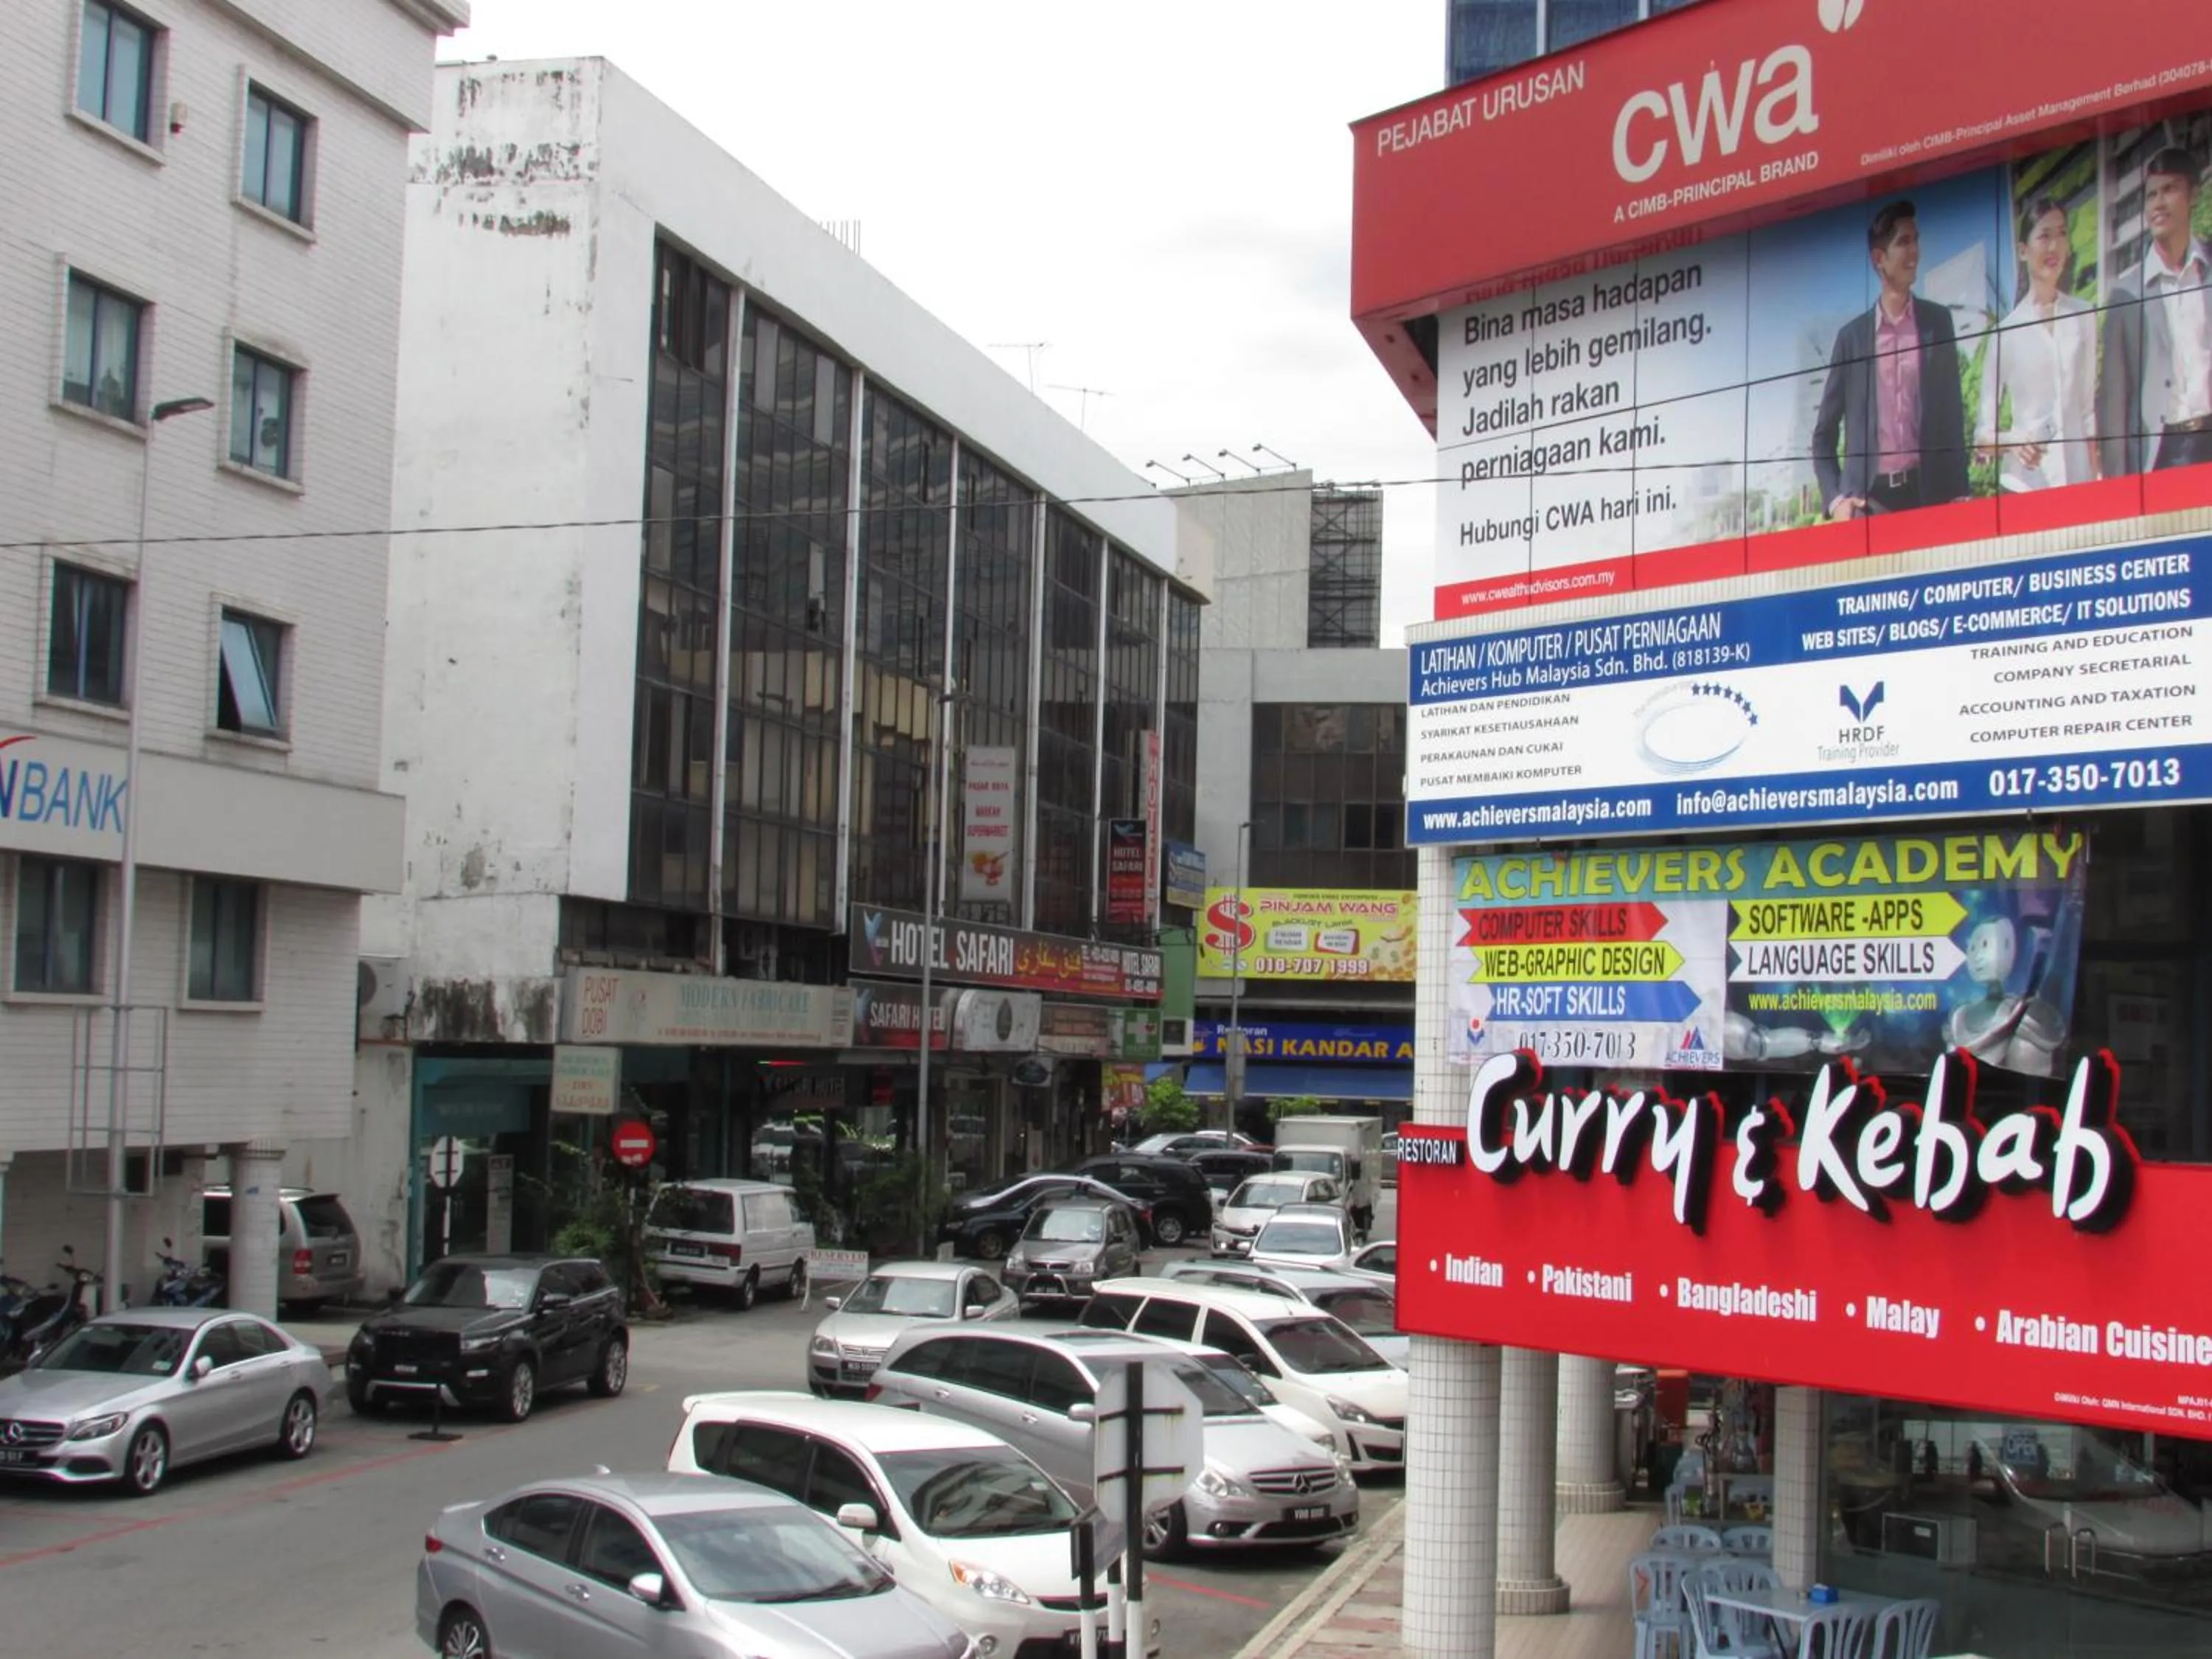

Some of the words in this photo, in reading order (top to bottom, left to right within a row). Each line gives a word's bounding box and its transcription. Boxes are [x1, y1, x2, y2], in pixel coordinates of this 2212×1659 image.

[1377, 98, 1476, 156] PEJABAT
[1483, 60, 1586, 121] URUSAN
[1923, 117, 2003, 150] CIMB-Principal
[2005, 108, 2036, 128] Asset
[2038, 86, 2111, 117] Management
[2114, 74, 2157, 97] Berhad
[1614, 206, 1625, 224] A
[1628, 169, 1756, 220] CIMB-PRINCIPAL
[1759, 151, 1819, 184] BRAND
[1464, 313, 1514, 346] Bina
[1521, 297, 1585, 330] masa
[1593, 262, 1702, 313] hadapan
[1463, 357, 1517, 397] yang
[1524, 337, 1581, 377] lebih
[1588, 312, 1712, 367] gemilang.
[1462, 394, 1544, 437] Jadilah
[1551, 380, 1620, 418] rakan
[1461, 434, 1591, 490] perniagaan
[1599, 415, 1666, 457] kami.
[1460, 509, 1540, 547] Hubungi
[1545, 499, 1594, 532] CWA
[1601, 490, 1640, 520] hari
[1646, 484, 1677, 514] ini.
[1461, 569, 1615, 605] www.cwealthadvisors.com.my
[1837, 588, 1919, 616] TRAINING/
[1924, 575, 2025, 606] COMPUTER/
[2028, 563, 2116, 594] BUSINESS
[2121, 554, 2191, 580] CENTER
[1801, 631, 1834, 652] WEB
[1837, 624, 1884, 648] SITES/
[1889, 616, 1949, 642] BLOGS/
[1953, 601, 2073, 636] E-COMMERCE/
[2077, 598, 2093, 619] IT
[2095, 588, 2191, 617] SOLUTIONS
[1420, 645, 1475, 675] LATIHAN
[1487, 632, 1563, 668] KOMPUTER
[1574, 625, 1621, 655] PUSAT
[1624, 611, 1722, 650] PERNIAGAAN
[1971, 640, 2048, 660] TRAINING
[2052, 636, 2089, 653] AND
[2093, 626, 2194, 647] EDUCATION
[1420, 673, 1488, 698] Achievers
[1492, 668, 1522, 690] Hub
[1526, 658, 1591, 689] Malaysia
[1595, 655, 1629, 678] Sdn.
[1633, 650, 1669, 672] Bhd.
[1672, 643, 1751, 672] (818139-K)
[1993, 664, 2074, 684] COMPANY
[2078, 653, 2191, 676] SECRETARIAL
[1420, 703, 1467, 719] LATIHAN
[1470, 699, 1495, 714] DAN
[1497, 693, 1571, 711] PENDIDIKAN
[1958, 695, 2066, 716] ACCOUNTING
[2069, 691, 2107, 706] AND
[2110, 684, 2196, 703] TAXATION
[1420, 724, 1472, 740] SYARIKAT
[1473, 715, 1579, 736] KESETIAUSAHAAN
[1839, 726, 1885, 745] HRDF
[1970, 725, 2059, 744] COMPUTER
[2063, 720, 2123, 737] REPAIR
[2126, 714, 2193, 733] CENTER
[1420, 746, 1496, 765] PERAKAUNAN
[1498, 743, 1524, 758] DAN
[1526, 740, 1564, 755] CUKAI
[1817, 743, 1857, 764] Training
[1859, 742, 1899, 760] Provider
[1420, 773, 1455, 788] PUSAT
[1455, 769, 1514, 785] MEMBAIKI
[1515, 764, 1582, 782] KOMPUTER
[1423, 798, 1652, 830] www.achieversmalaysia.com
[1677, 776, 1958, 815] info@achieversmalaysia.com
[1989, 757, 2180, 797] 017-350-7013
[1113, 846, 1140, 859] HOTEL
[1458, 848, 1746, 902] ACHIEVERS
[1763, 832, 2083, 889] ACADEMY
[1259, 899, 1333, 914] PINJAM
[1338, 901, 1399, 915] WANG
[1749, 902, 1856, 936] SOFTWARE
[1478, 909, 1565, 940] COMPUTER
[1568, 908, 1627, 938] SKILLS
[956, 930, 1015, 976] SAFARI
[1256, 956, 1324, 974] 010-707
[1326, 959, 1369, 975] 1999
[1484, 947, 1596, 978] WEB-GRAPHIC
[1601, 947, 1666, 975] DESIGN
[1748, 945, 1857, 976] LANGUAGE
[1863, 942, 1935, 974] SKILLS
[583, 975, 620, 1004] PUSAT
[1495, 986, 1562, 1017] HR-SOFT
[1566, 986, 1627, 1016] SKILLS
[1748, 989, 1937, 1016] www.achieversmalaysia.com
[870, 1001, 911, 1028] SAFARI
[911, 1004, 945, 1031] HTEL
[1281, 1039, 1389, 1059] KANDAR
[1664, 1049, 1721, 1065] ACHIEVERS
[1397, 1136, 1457, 1165] RESTORAN
[1467, 1053, 1699, 1225] Curry
[1797, 1054, 2111, 1222] Kebab
[810, 1250, 866, 1263] RESERVED
[1445, 1253, 1504, 1288] Indian
[1542, 1264, 1632, 1302] Pakistani
[1677, 1277, 1817, 1323] Bangladeshi
[1866, 1295, 1941, 1340] Malay
[1996, 1309, 2098, 1355] Arabian
[2106, 1321, 2212, 1367] Cuisine
